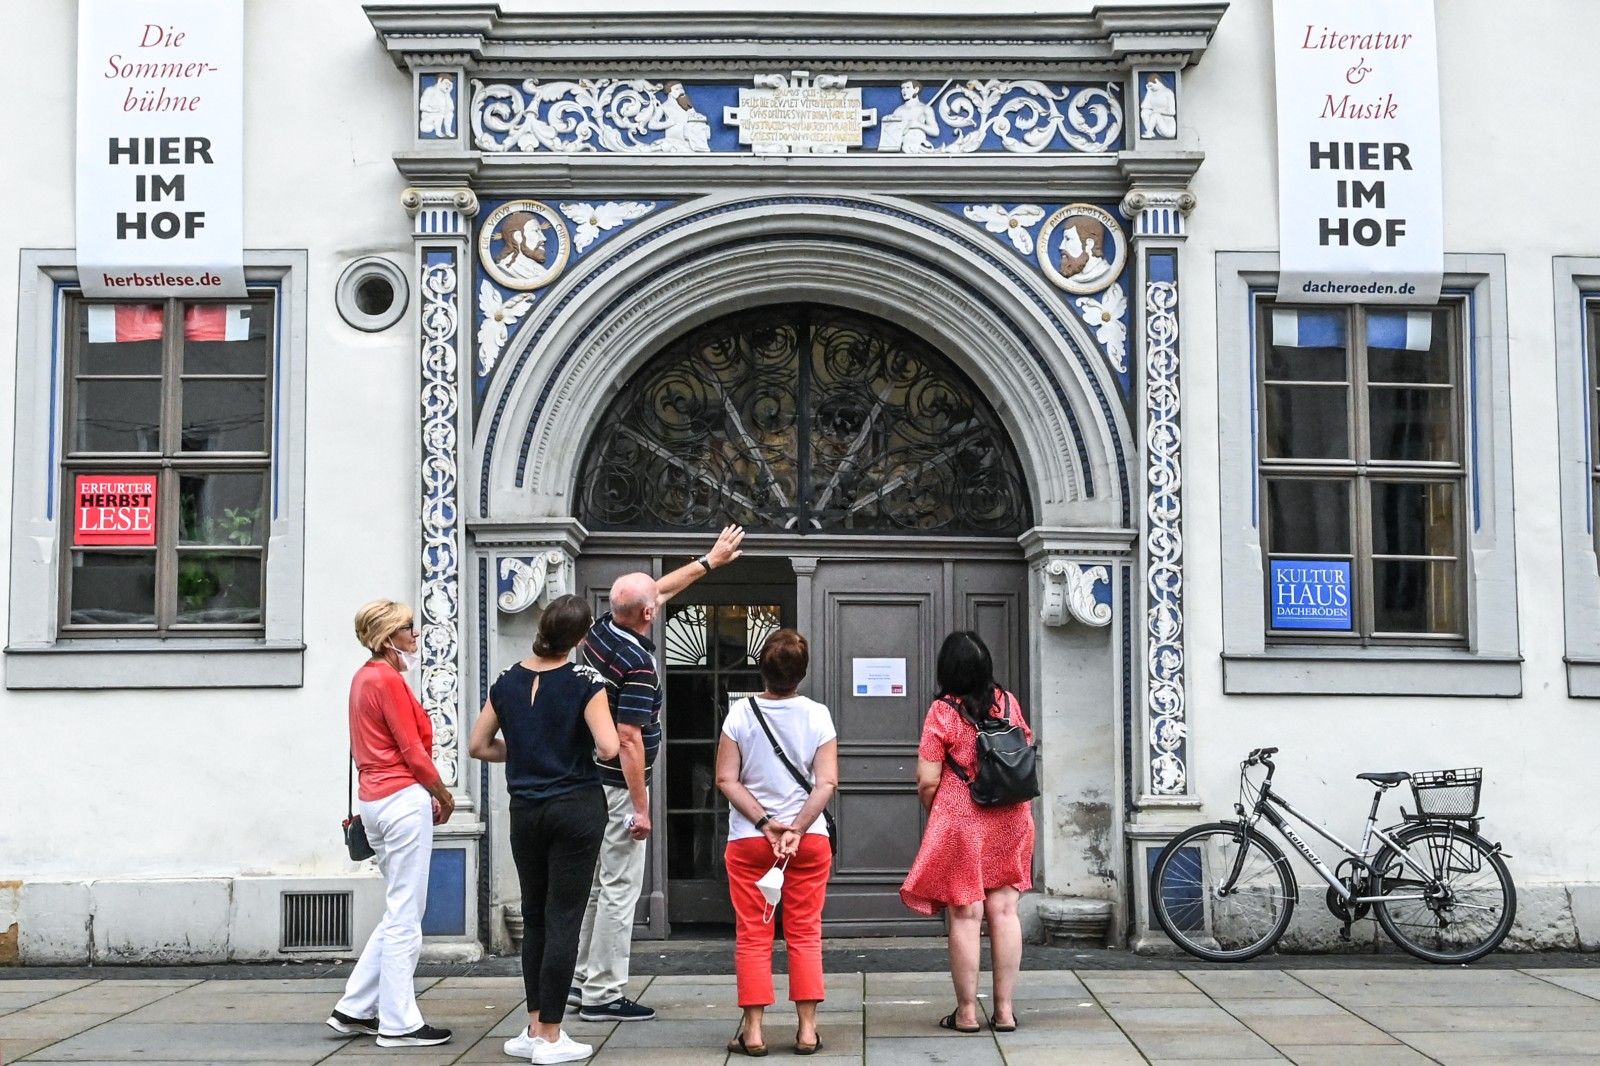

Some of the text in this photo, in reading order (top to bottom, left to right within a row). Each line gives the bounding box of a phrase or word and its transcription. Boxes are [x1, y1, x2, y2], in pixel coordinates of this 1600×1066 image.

[139, 24, 186, 48] Die
[1301, 25, 1412, 50] Literatur
[105, 54, 218, 79] Sommer-
[1346, 57, 1373, 84] &
[123, 87, 201, 112] bühne
[1319, 94, 1398, 120] Musik
[109, 137, 214, 164] HIER
[1310, 142, 1413, 171] HIER
[136, 174, 185, 202] IM
[1337, 180, 1385, 209] IM
[116, 211, 205, 240] HOF
[1319, 217, 1406, 247] HOF
[103, 272, 221, 287] herbstlese.de
[1302, 280, 1415, 295] dacheroeden.de
[80, 483, 152, 494] ERFURTER
[81, 494, 152, 507] HERBST
[79, 507, 152, 530] LESE
[1277, 568, 1345, 584] KULTUR
[1277, 583, 1347, 606] HAUS
[1277, 607, 1348, 616] DACHERÖDEN
